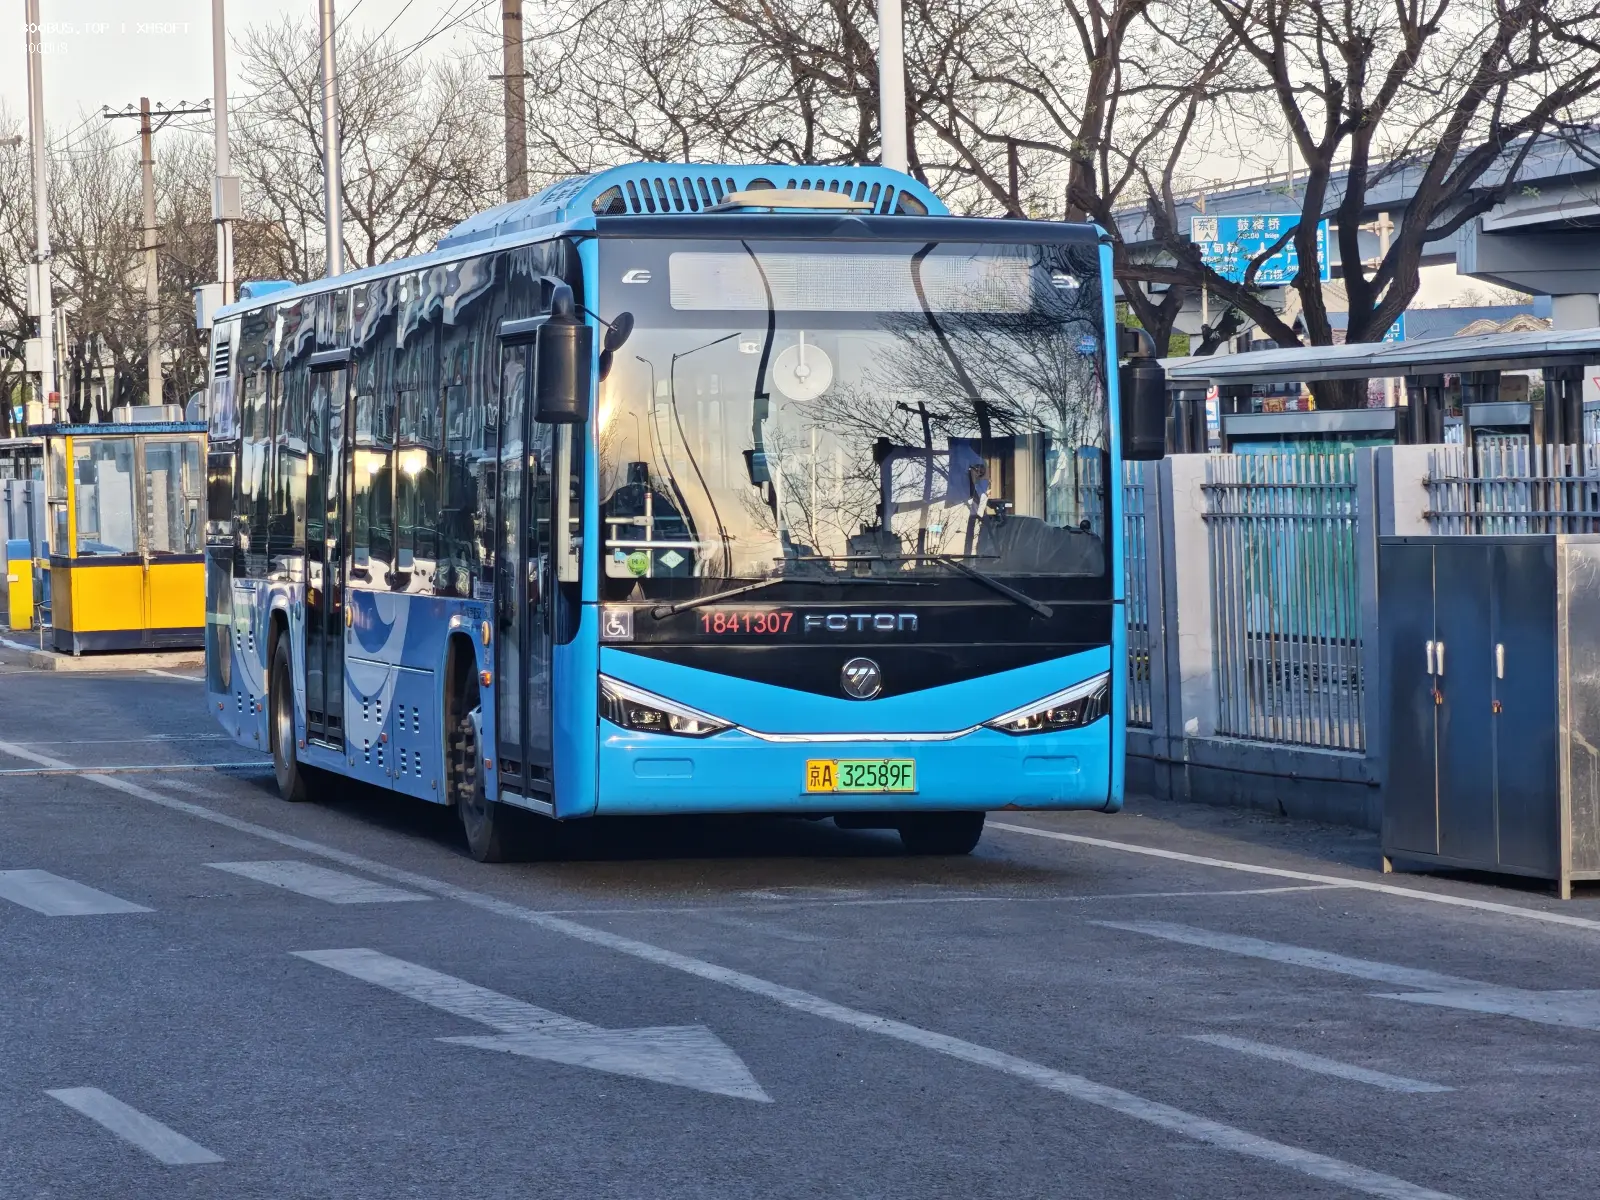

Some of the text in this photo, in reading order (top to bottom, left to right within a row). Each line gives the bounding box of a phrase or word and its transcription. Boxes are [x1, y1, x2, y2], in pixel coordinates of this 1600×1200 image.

[1237, 217, 1280, 231] 鼓楼桥
[700, 611, 793, 634] 1841307
[803, 612, 918, 633] FOTON
[810, 764, 912, 787] 京A 32589F
